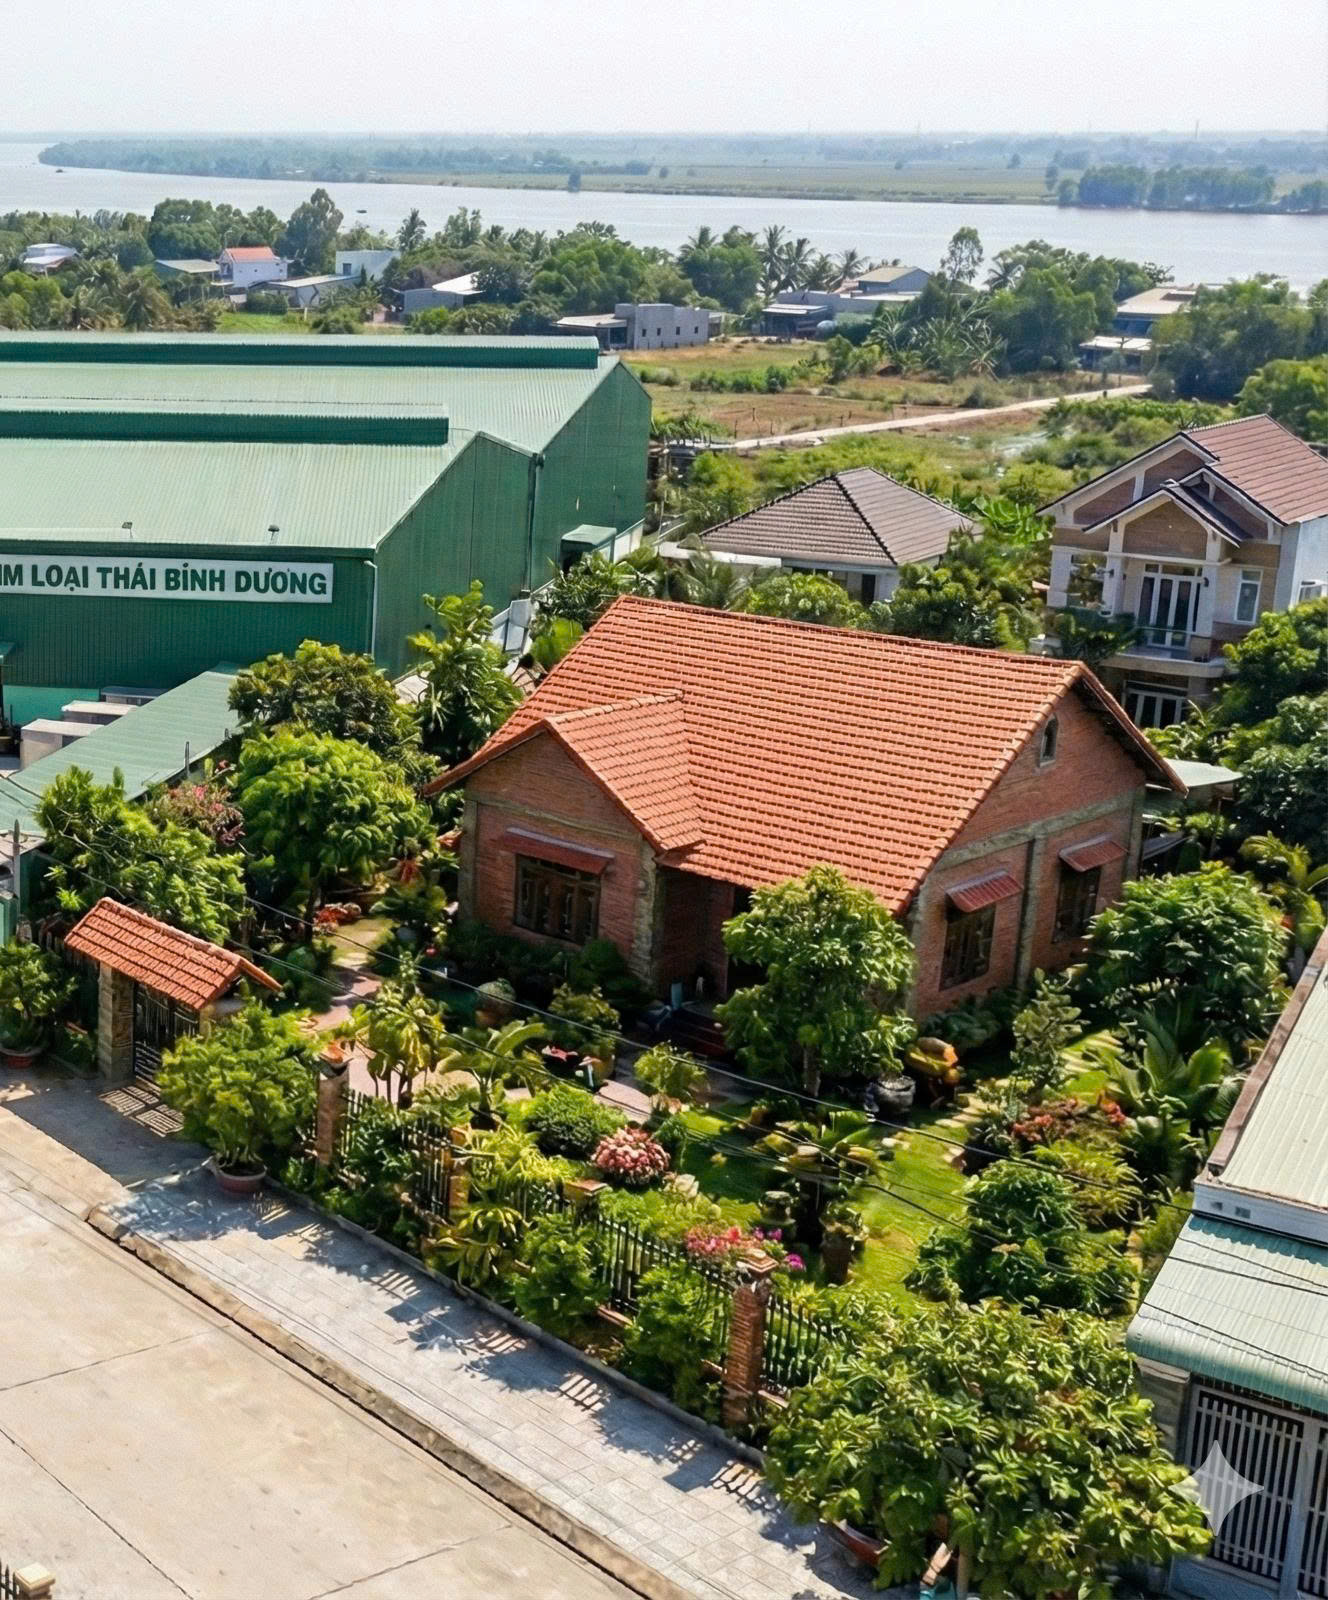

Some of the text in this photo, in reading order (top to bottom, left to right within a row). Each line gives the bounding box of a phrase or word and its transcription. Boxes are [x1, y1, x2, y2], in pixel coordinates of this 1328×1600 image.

[30, 563, 89, 592] LOẠI
[95, 561, 157, 591] THÁI
[234, 566, 328, 596] DƯƠNG
